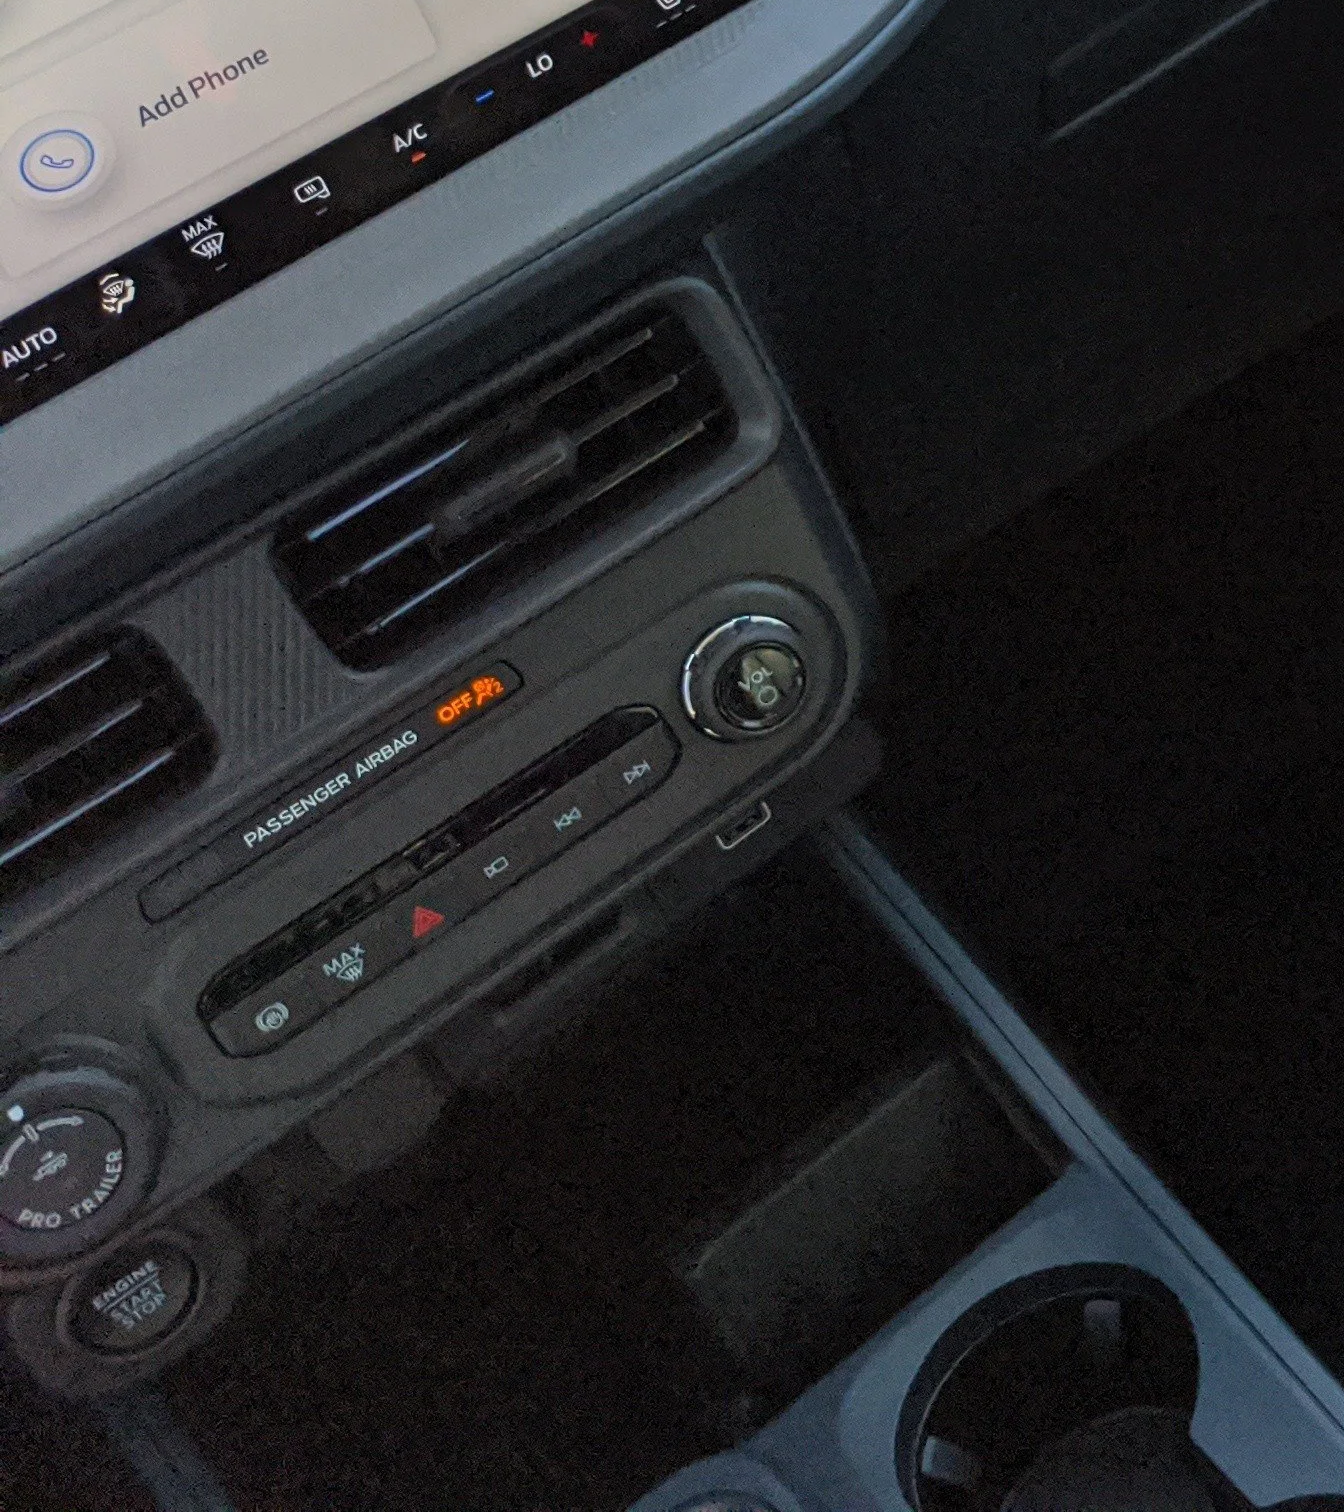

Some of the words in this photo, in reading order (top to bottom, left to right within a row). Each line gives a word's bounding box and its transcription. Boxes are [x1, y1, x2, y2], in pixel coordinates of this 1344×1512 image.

[135, 83, 188, 128] Add
[187, 43, 271, 104] Phone
[525, 52, 555, 81] LO
[392, 121, 430, 154] A/C
[181, 213, 219, 244] MAX
[2, 326, 57, 369] AUTO
[737, 662, 774, 692] VOL
[242, 771, 352, 849] PASSENGER
[355, 729, 419, 779] AIRBAG
[437, 691, 473, 724] OFF
[322, 942, 366, 977] MAX
[18, 1208, 62, 1229] PRO
[69, 1148, 124, 1220] TRAILER
[92, 1260, 159, 1311] ENGINE
[110, 1280, 165, 1322] START
[121, 1292, 168, 1331] STOP
